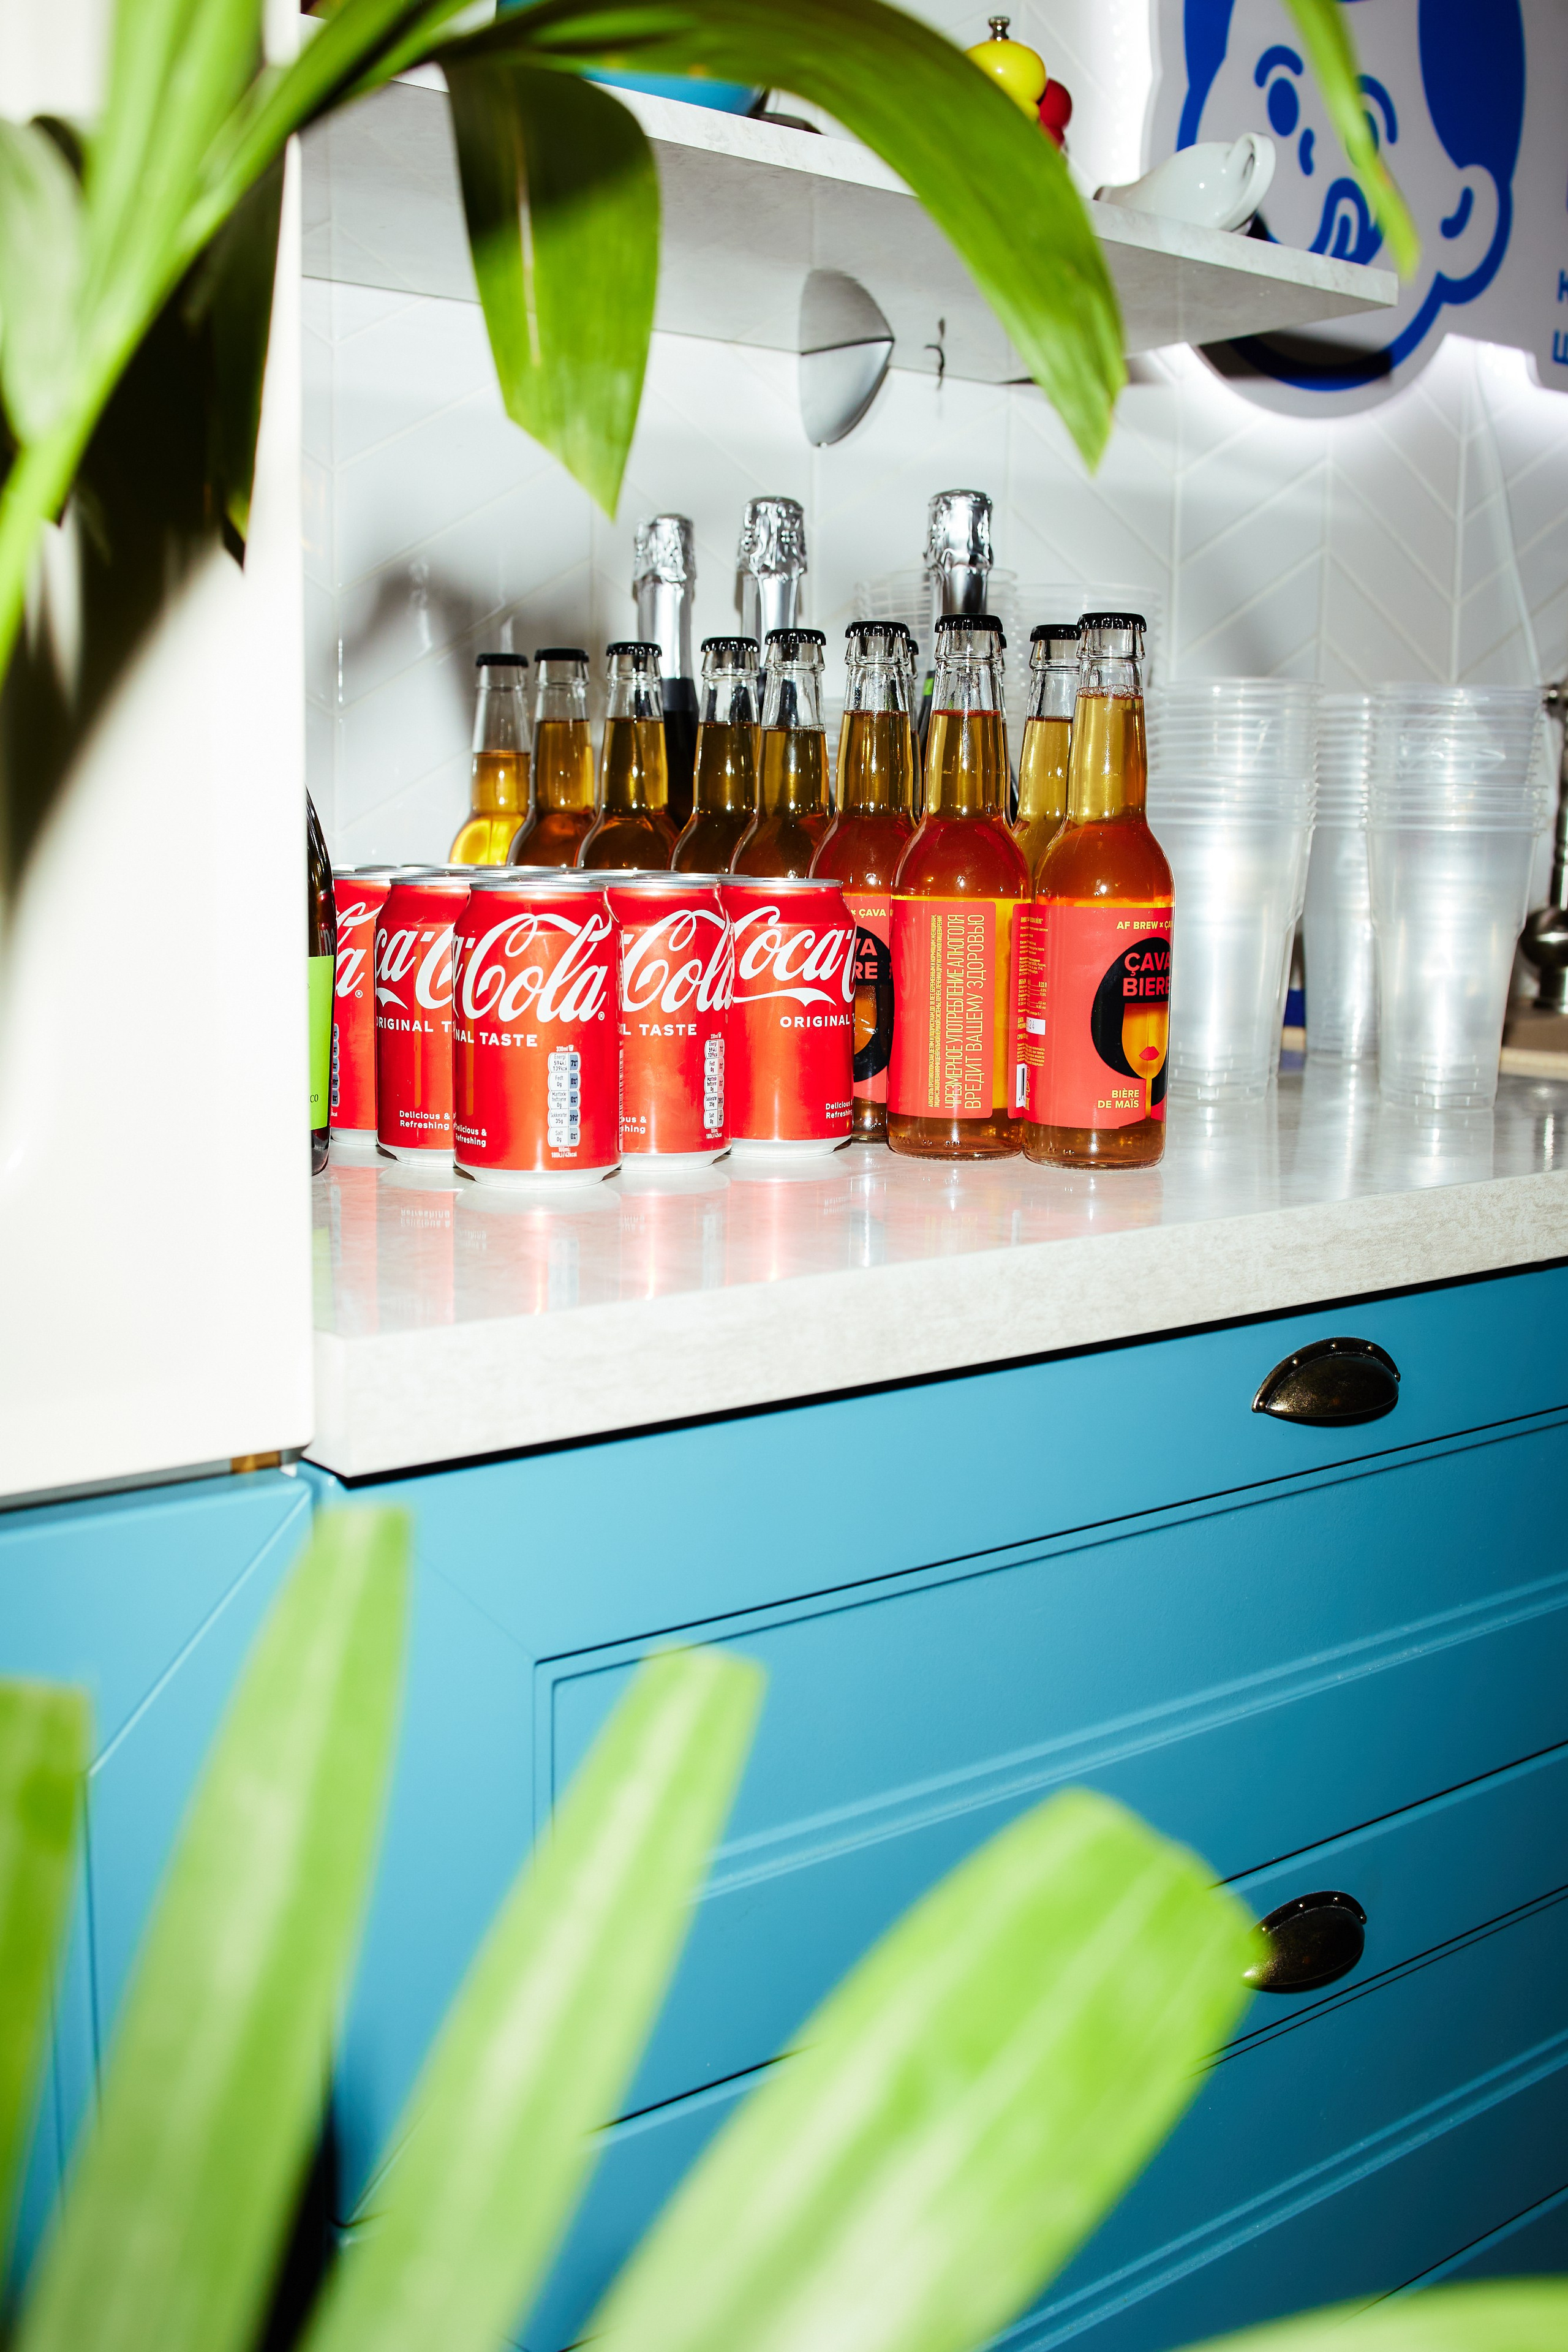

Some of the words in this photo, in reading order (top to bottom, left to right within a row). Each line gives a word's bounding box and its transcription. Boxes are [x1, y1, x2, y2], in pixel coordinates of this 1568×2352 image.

[858, 908, 887, 918] ÇAVA
[1133, 921, 1158, 929] BREW
[946, 914, 965, 968] АЛКОГОЛЯ
[967, 914, 987, 989] ЗДОРОВЬЮ
[946, 969, 964, 1044] УПОТРЕБЛЕНИЕ
[780, 1014, 850, 1028] ORIGINAL
[965, 993, 983, 1051] ВАШЕМУ
[639, 1023, 697, 1036] TASTE
[480, 1031, 538, 1047] TASTE
[944, 1045, 963, 1108] ЧРЕЗМЕРНОЕ
[965, 1055, 984, 1109] ВРЕДИТ
[1112, 1088, 1139, 1098] BIÈRE
[826, 1101, 851, 1110] Delicious
[1115, 1098, 1139, 1108] MAÏS
[399, 1110, 440, 1120] Delicious
[400, 1120, 450, 1131] Refreshing
